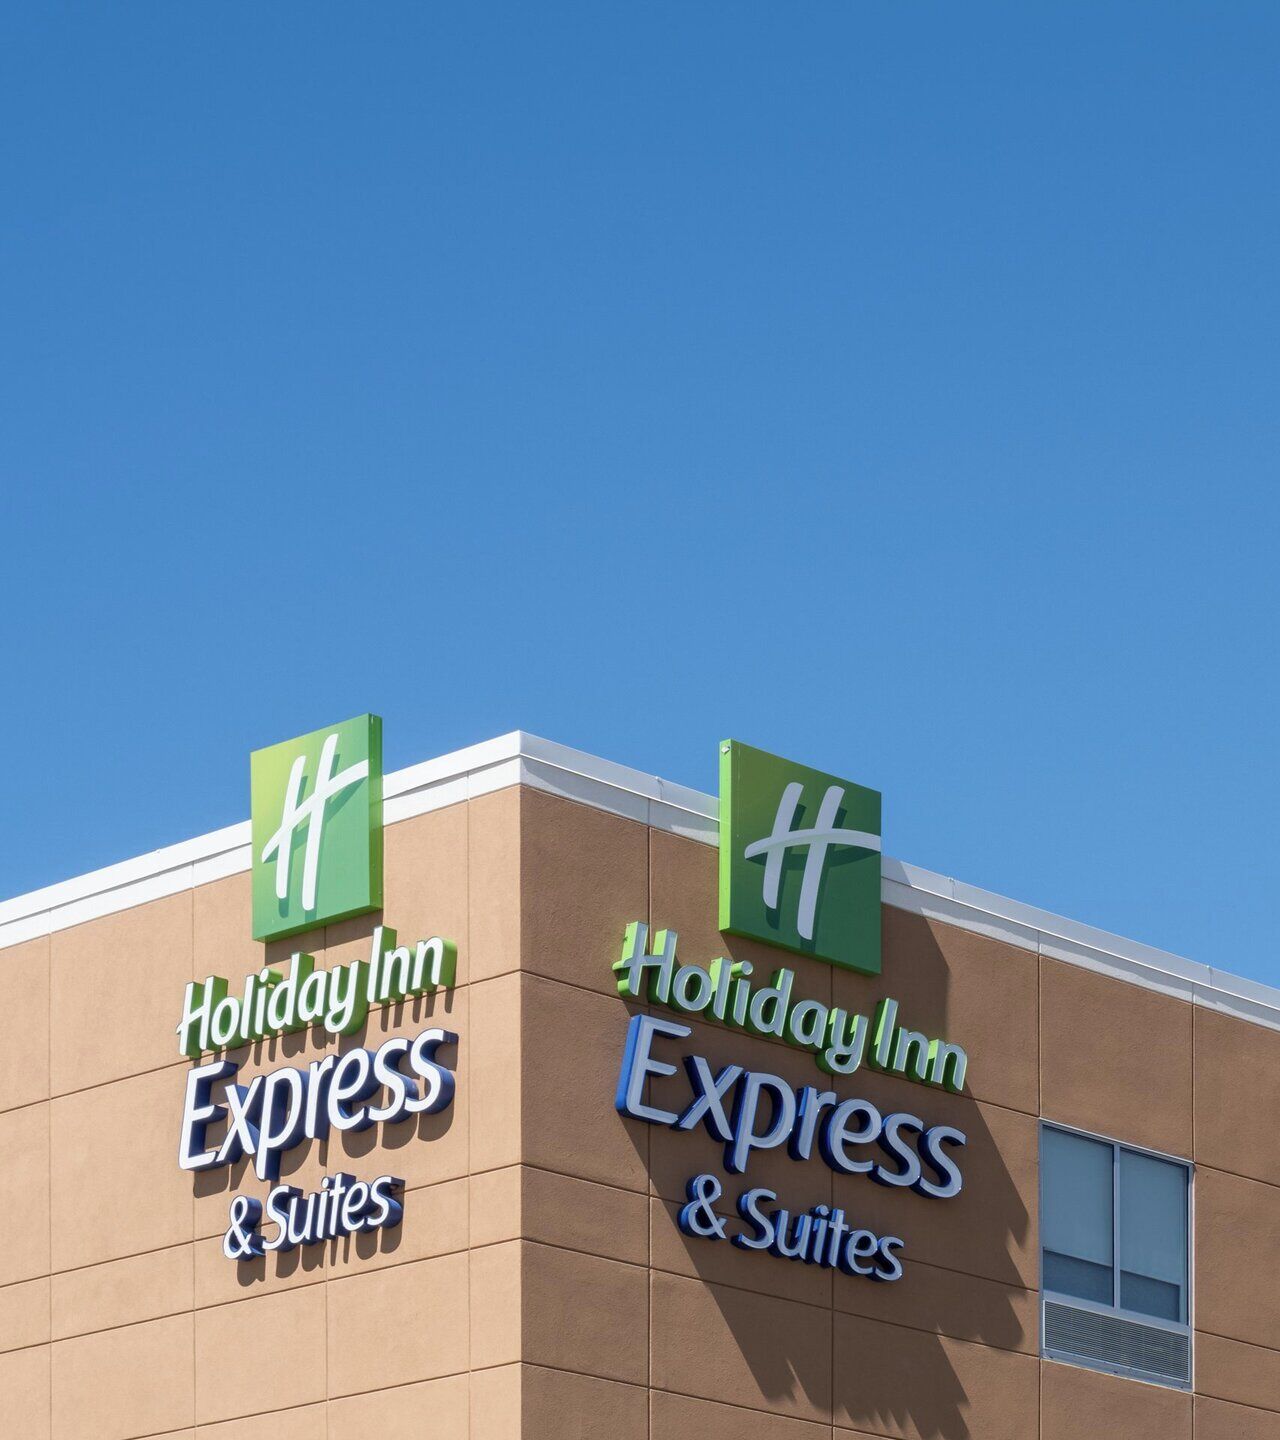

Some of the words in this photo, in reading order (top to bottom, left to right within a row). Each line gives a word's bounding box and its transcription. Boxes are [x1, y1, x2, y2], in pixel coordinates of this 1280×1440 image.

[177, 951, 366, 1057] Holiday
[367, 925, 455, 1003] Inn
[612, 921, 869, 1074] Holiday
[867, 997, 968, 1091] Inn
[178, 1027, 457, 1180] Express
[615, 1014, 967, 1199] Express
[223, 1195, 260, 1261] &
[261, 1172, 402, 1251] Suites
[678, 1173, 726, 1241] &
[732, 1187, 905, 1283] Suites
